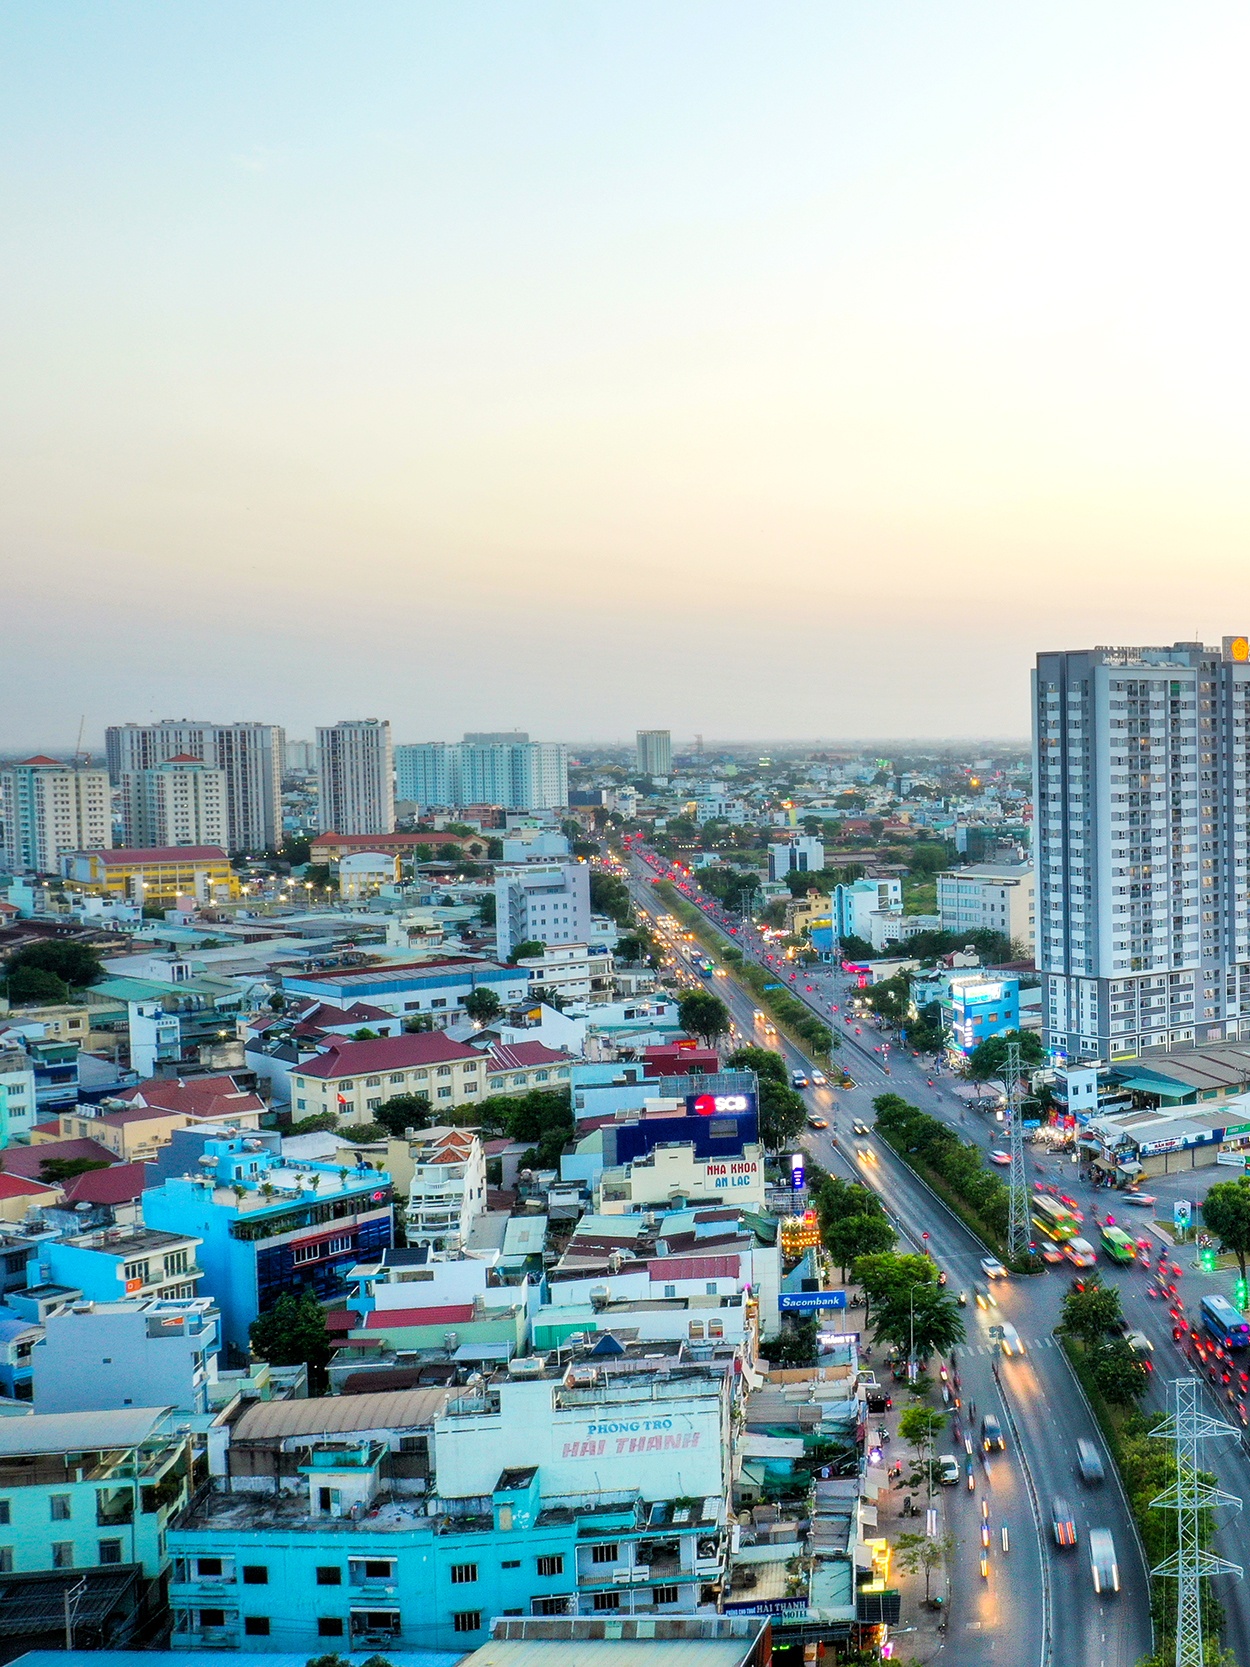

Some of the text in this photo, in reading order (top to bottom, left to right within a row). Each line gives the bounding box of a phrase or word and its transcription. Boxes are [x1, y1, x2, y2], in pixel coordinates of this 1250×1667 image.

[715, 1097, 746, 1111] SCB
[707, 1162, 757, 1175] NHA KHOA
[715, 1177, 728, 1187] AN
[782, 1296, 840, 1307] Sacombank
[562, 1432, 700, 1458] HẢI THANH
